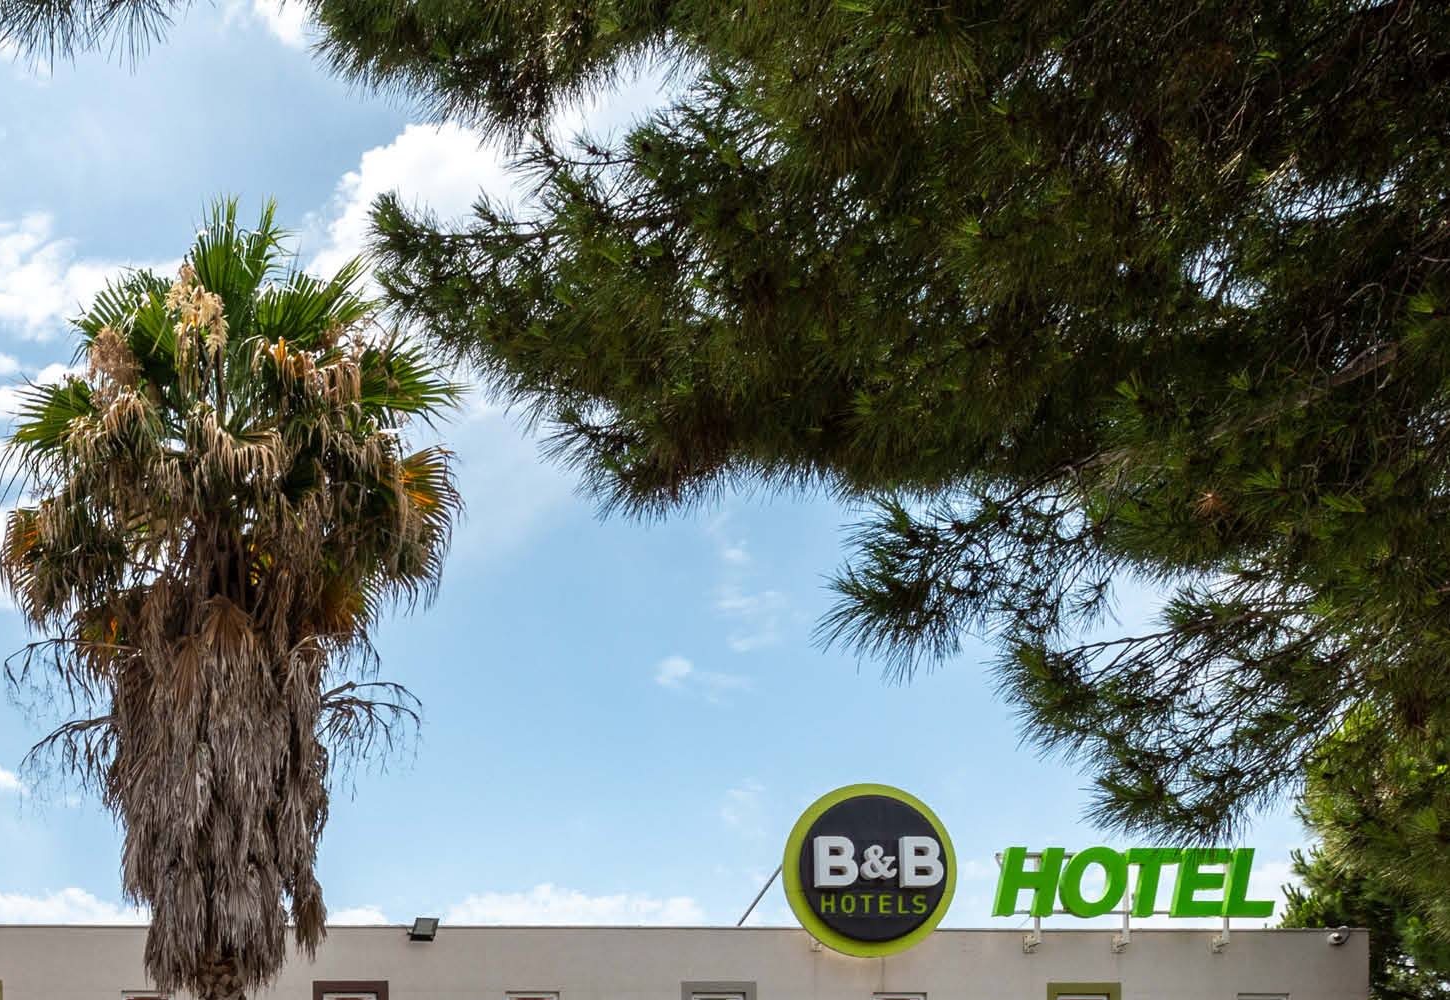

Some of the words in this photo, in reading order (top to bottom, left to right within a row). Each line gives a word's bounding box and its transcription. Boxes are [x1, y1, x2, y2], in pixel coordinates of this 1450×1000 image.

[813, 836, 944, 888] B&B
[991, 846, 1275, 918] HOTEL
[820, 894, 928, 915] HOTELS
